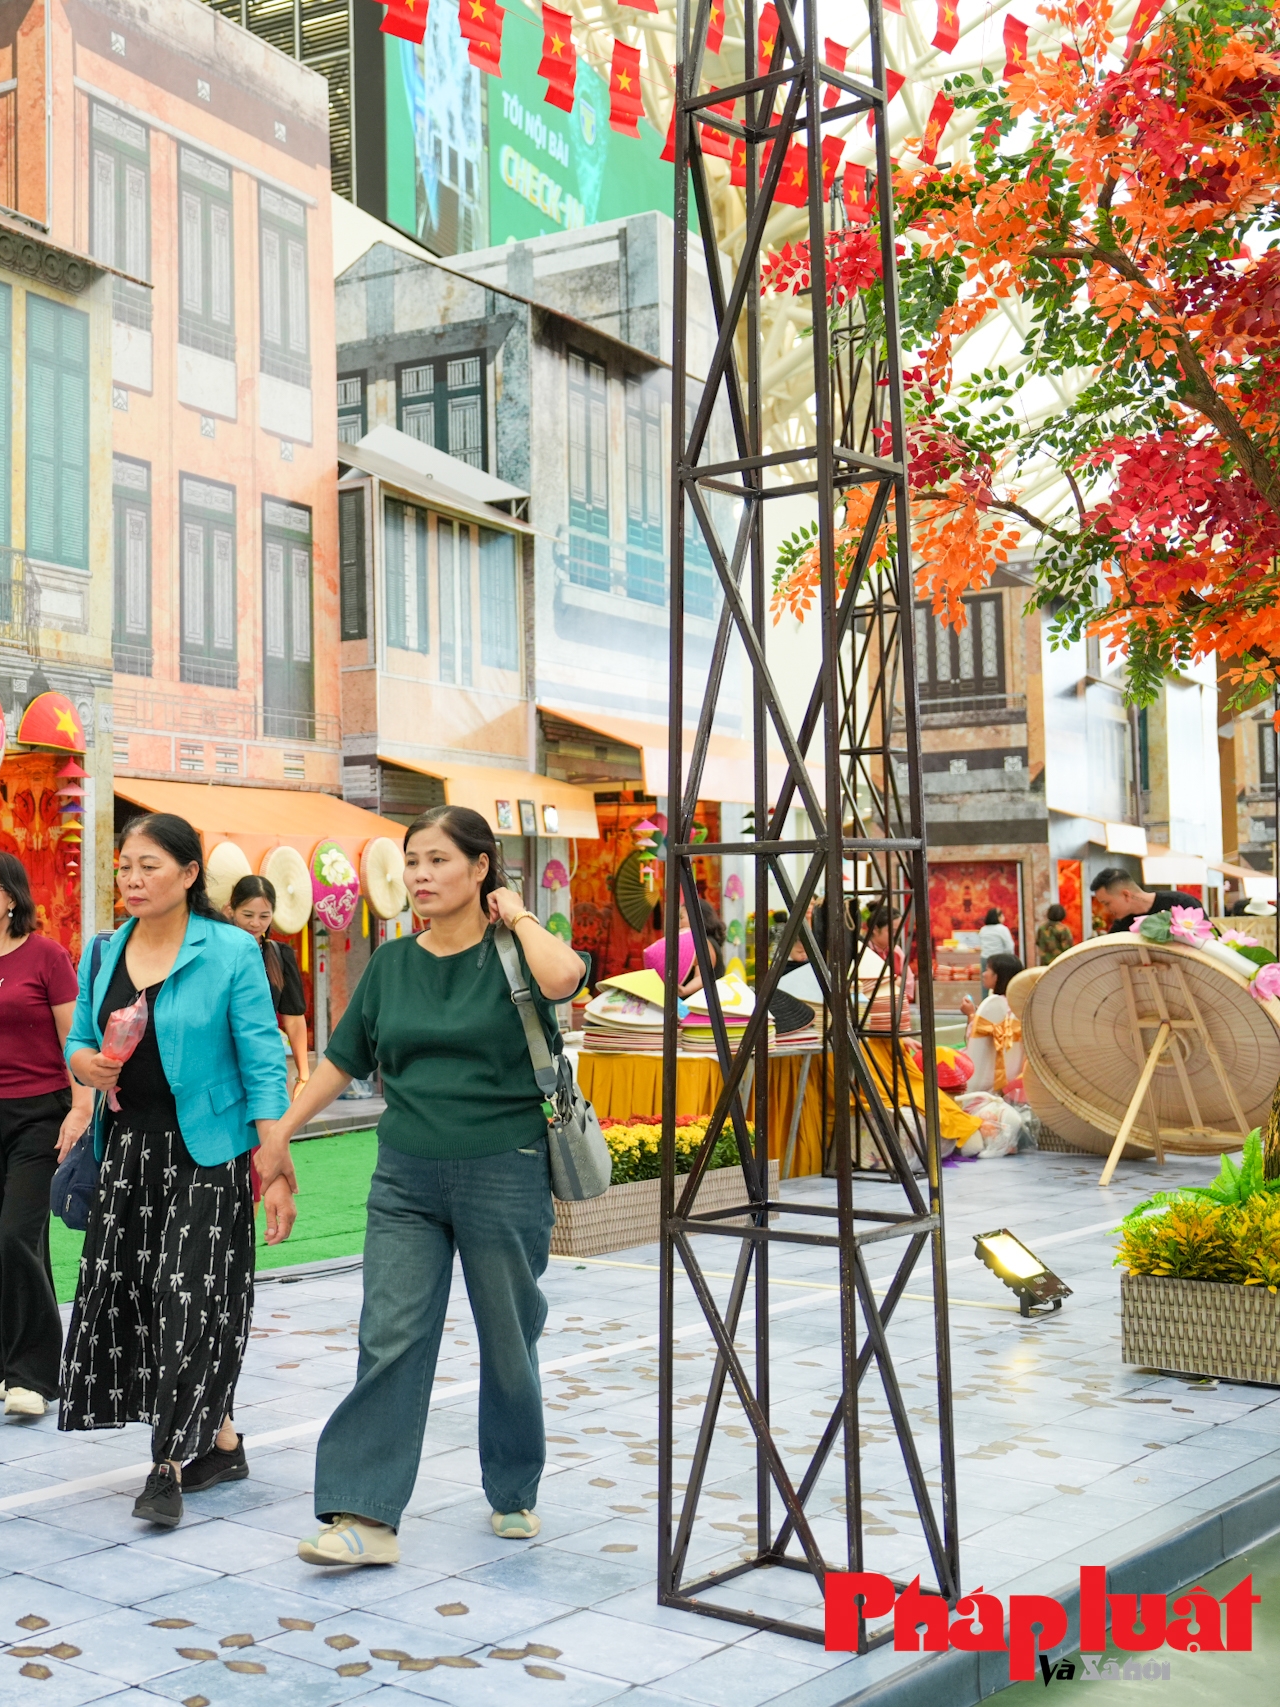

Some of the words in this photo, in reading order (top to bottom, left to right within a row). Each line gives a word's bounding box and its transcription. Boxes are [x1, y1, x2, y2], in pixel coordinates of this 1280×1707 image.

[525, 110, 547, 150] NỘI
[548, 130, 569, 168] BÀI
[499, 144, 585, 230] CHECK-IN
